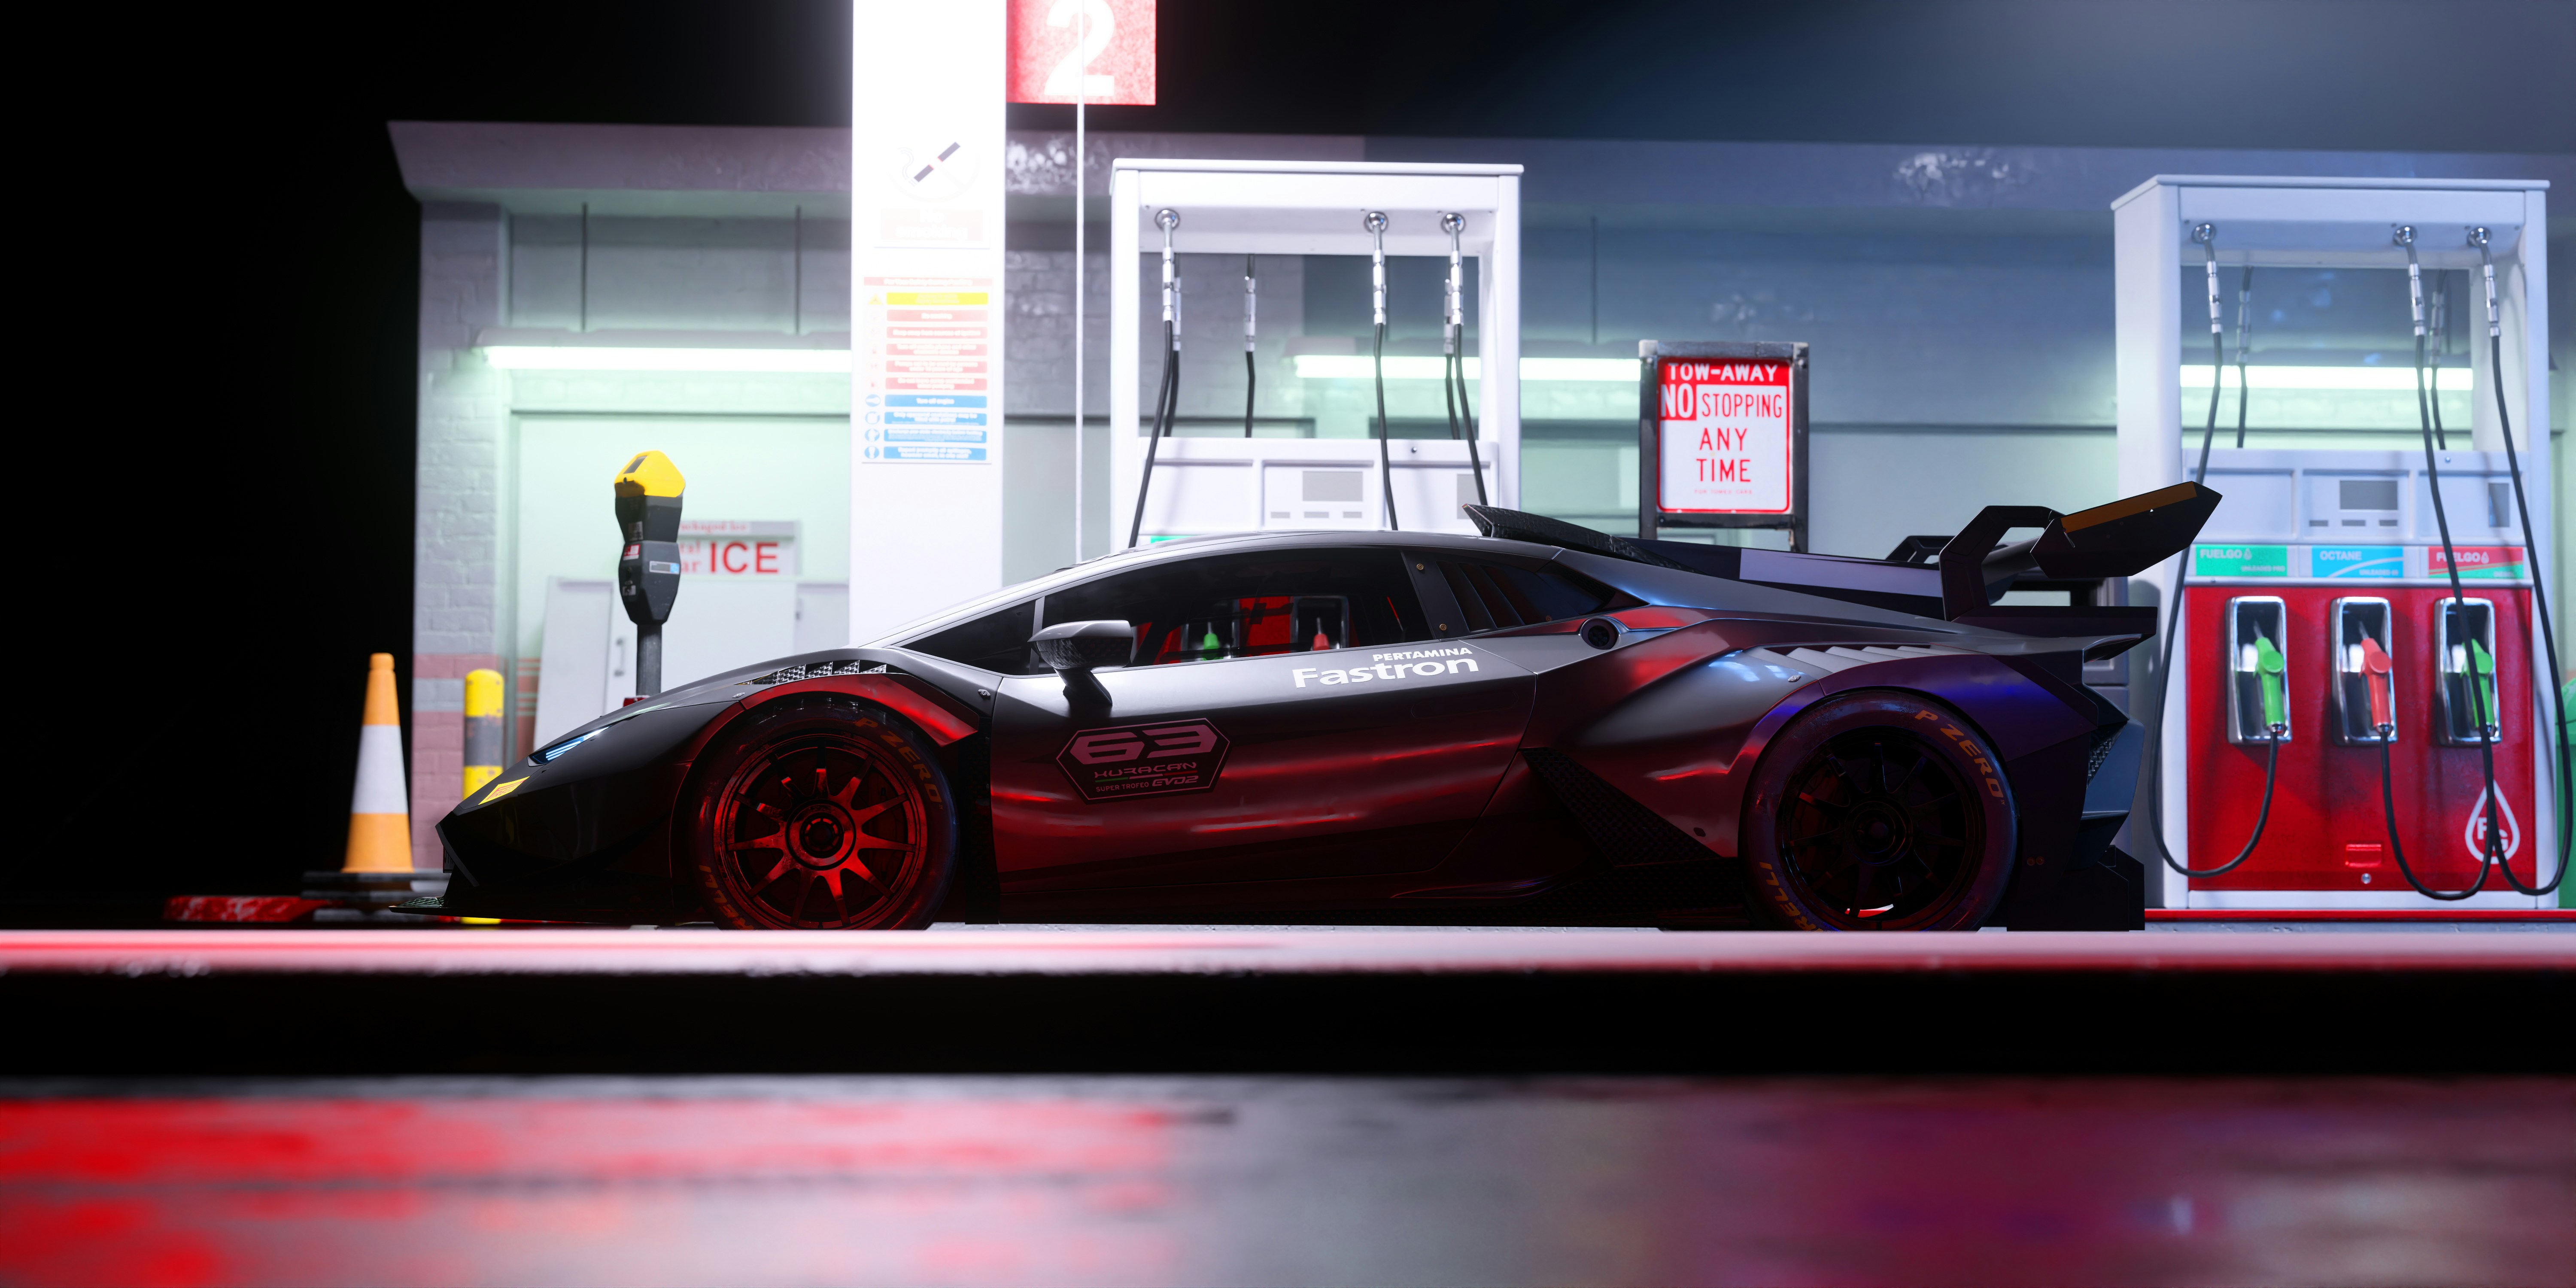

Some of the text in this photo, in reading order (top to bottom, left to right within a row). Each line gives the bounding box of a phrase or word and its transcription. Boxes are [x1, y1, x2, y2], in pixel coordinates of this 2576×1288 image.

[1045, 0, 1115, 96] 2
[1668, 363, 1777, 382] TOW-AWAY
[1661, 383, 1782, 418] NO STOPPING
[1699, 428, 1747, 451] ANY
[1696, 459, 1751, 482] TIME
[710, 541, 779, 574] ICE
[2199, 549, 2242, 559] FUELGO
[2320, 551, 2362, 560] OCTANE
[1373, 647, 1473, 662] PERTAMINA
[1292, 658, 1479, 688] Fastron
[1914, 710, 1938, 721] P
[1070, 724, 1217, 765] 63
[1152, 775, 1199, 787] EVO2
[699, 865, 754, 930] RELLI
[1759, 862, 1823, 930] RELLI
